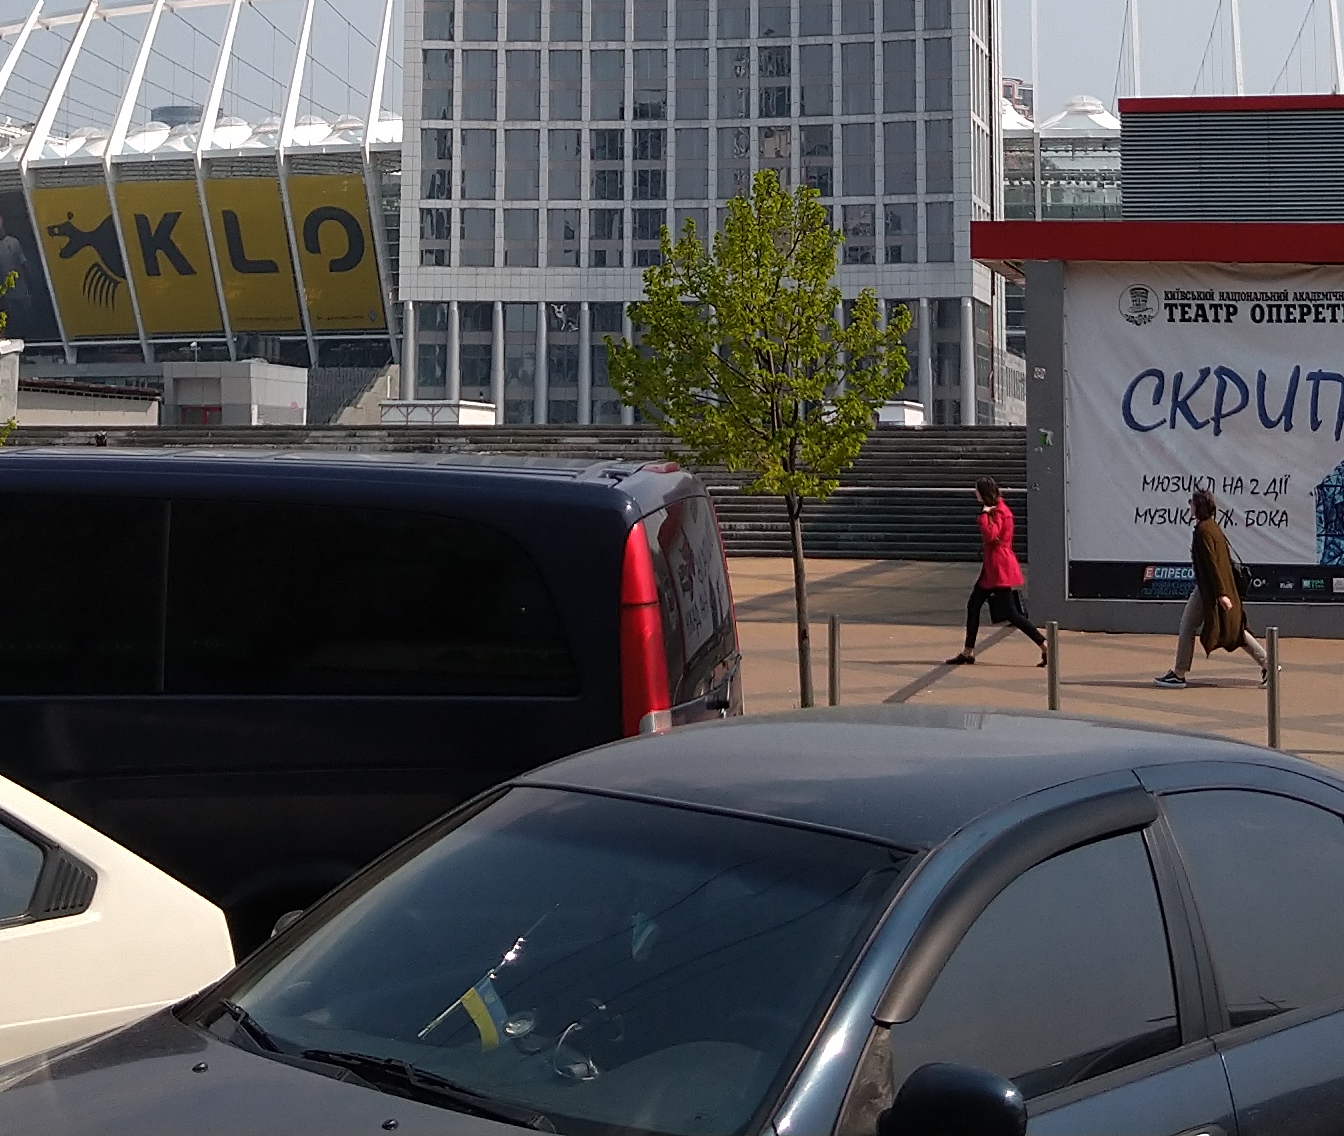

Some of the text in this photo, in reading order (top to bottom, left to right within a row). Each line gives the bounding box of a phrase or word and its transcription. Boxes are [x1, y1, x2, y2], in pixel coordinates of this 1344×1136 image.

[134, 205, 365, 277] KLO
[1164, 288, 1215, 301] КИЇВСЬКИЙ
[1218, 288, 1290, 302] НАЦІОНАЛЬНИЙ
[1164, 303, 1238, 323] ТЕАТР
[1222, 476, 1244, 495] НА
[1250, 478, 1260, 496] 2
[1263, 474, 1291, 501] ДІЇ
[1212, 508, 1238, 529] Ж.
[1245, 510, 1289, 528] БОКА
[1145, 566, 1194, 580] ЕСПРЕСО
